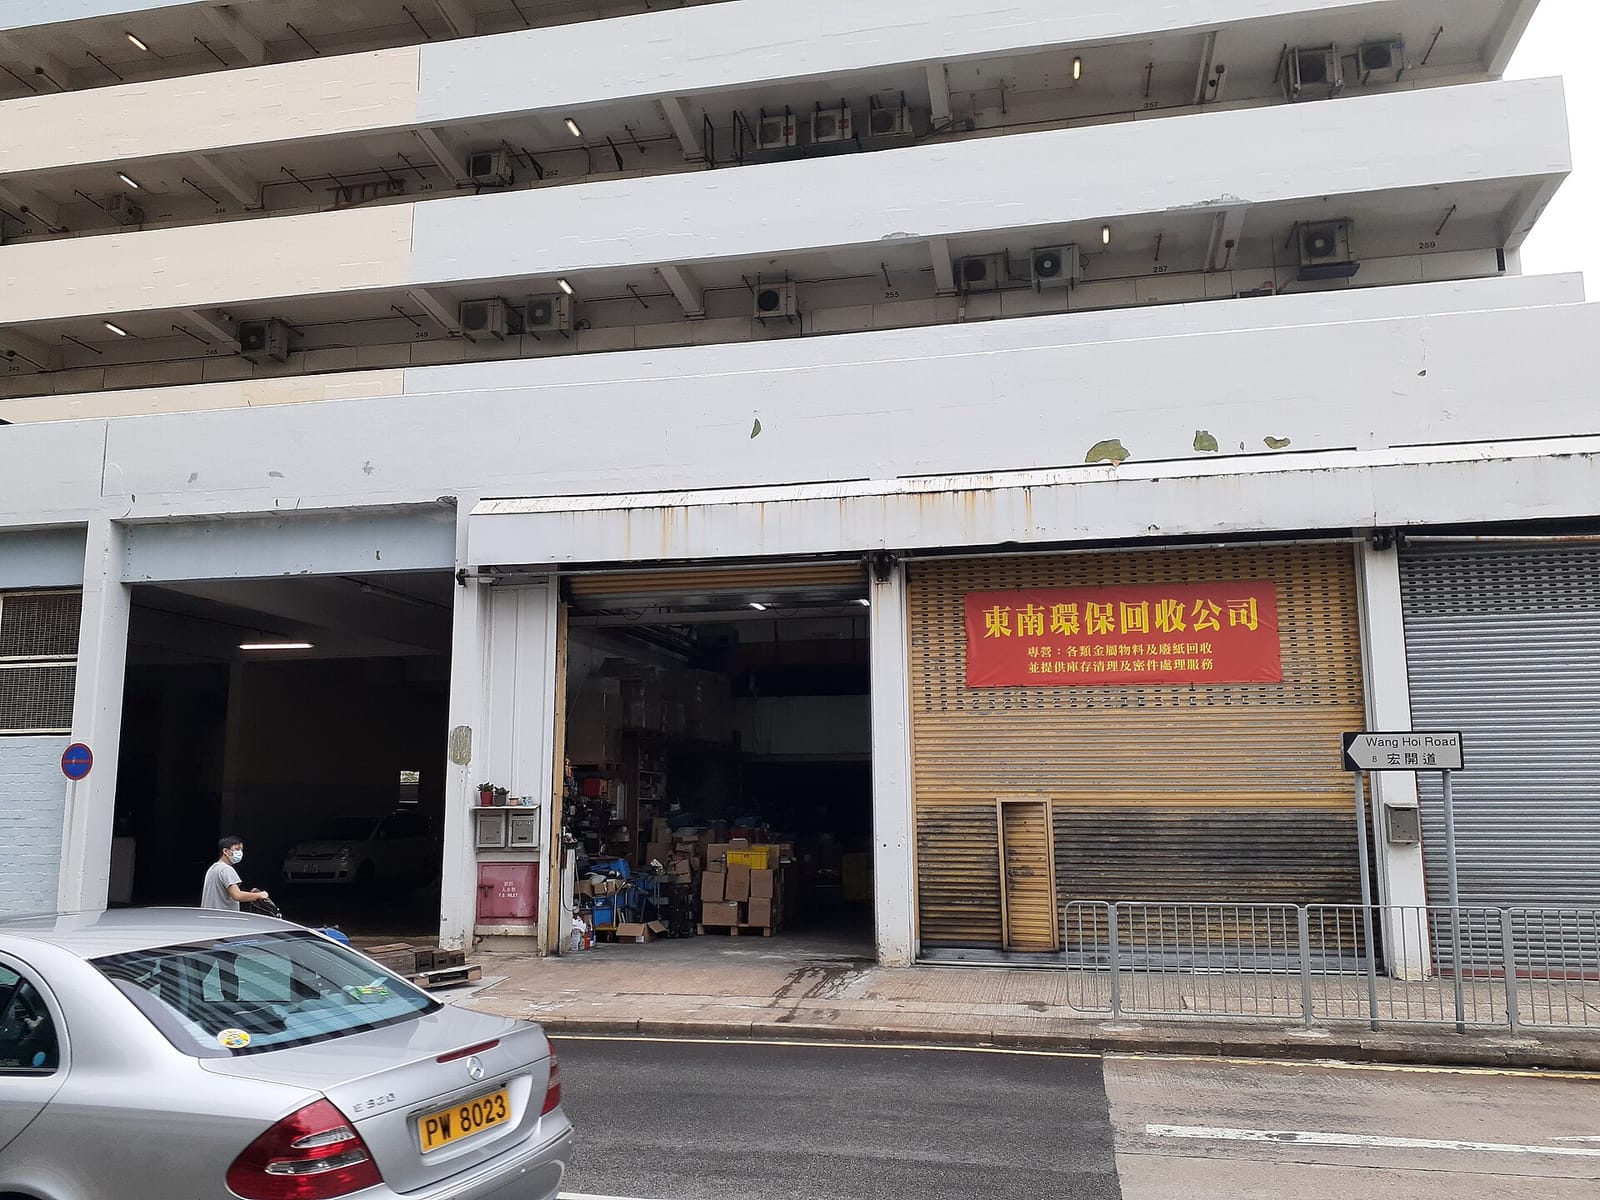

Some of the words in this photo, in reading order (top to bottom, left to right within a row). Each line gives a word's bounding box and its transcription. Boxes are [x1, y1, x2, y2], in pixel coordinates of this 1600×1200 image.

[1152, 265, 1169, 273] 257
[884, 291, 900, 299] 255
[982, 597, 1258, 638] 東南環保回收公司
[1028, 658, 1213, 673] 並提供庫存清理及密件處理服務
[1366, 737, 1399, 748] Wang
[1402, 737, 1421, 747] Hoi
[1425, 736, 1457, 747] Road
[1387, 752, 1437, 766] 宏開道
[425, 1113, 451, 1146] PW
[460, 1094, 506, 1132] 8023
